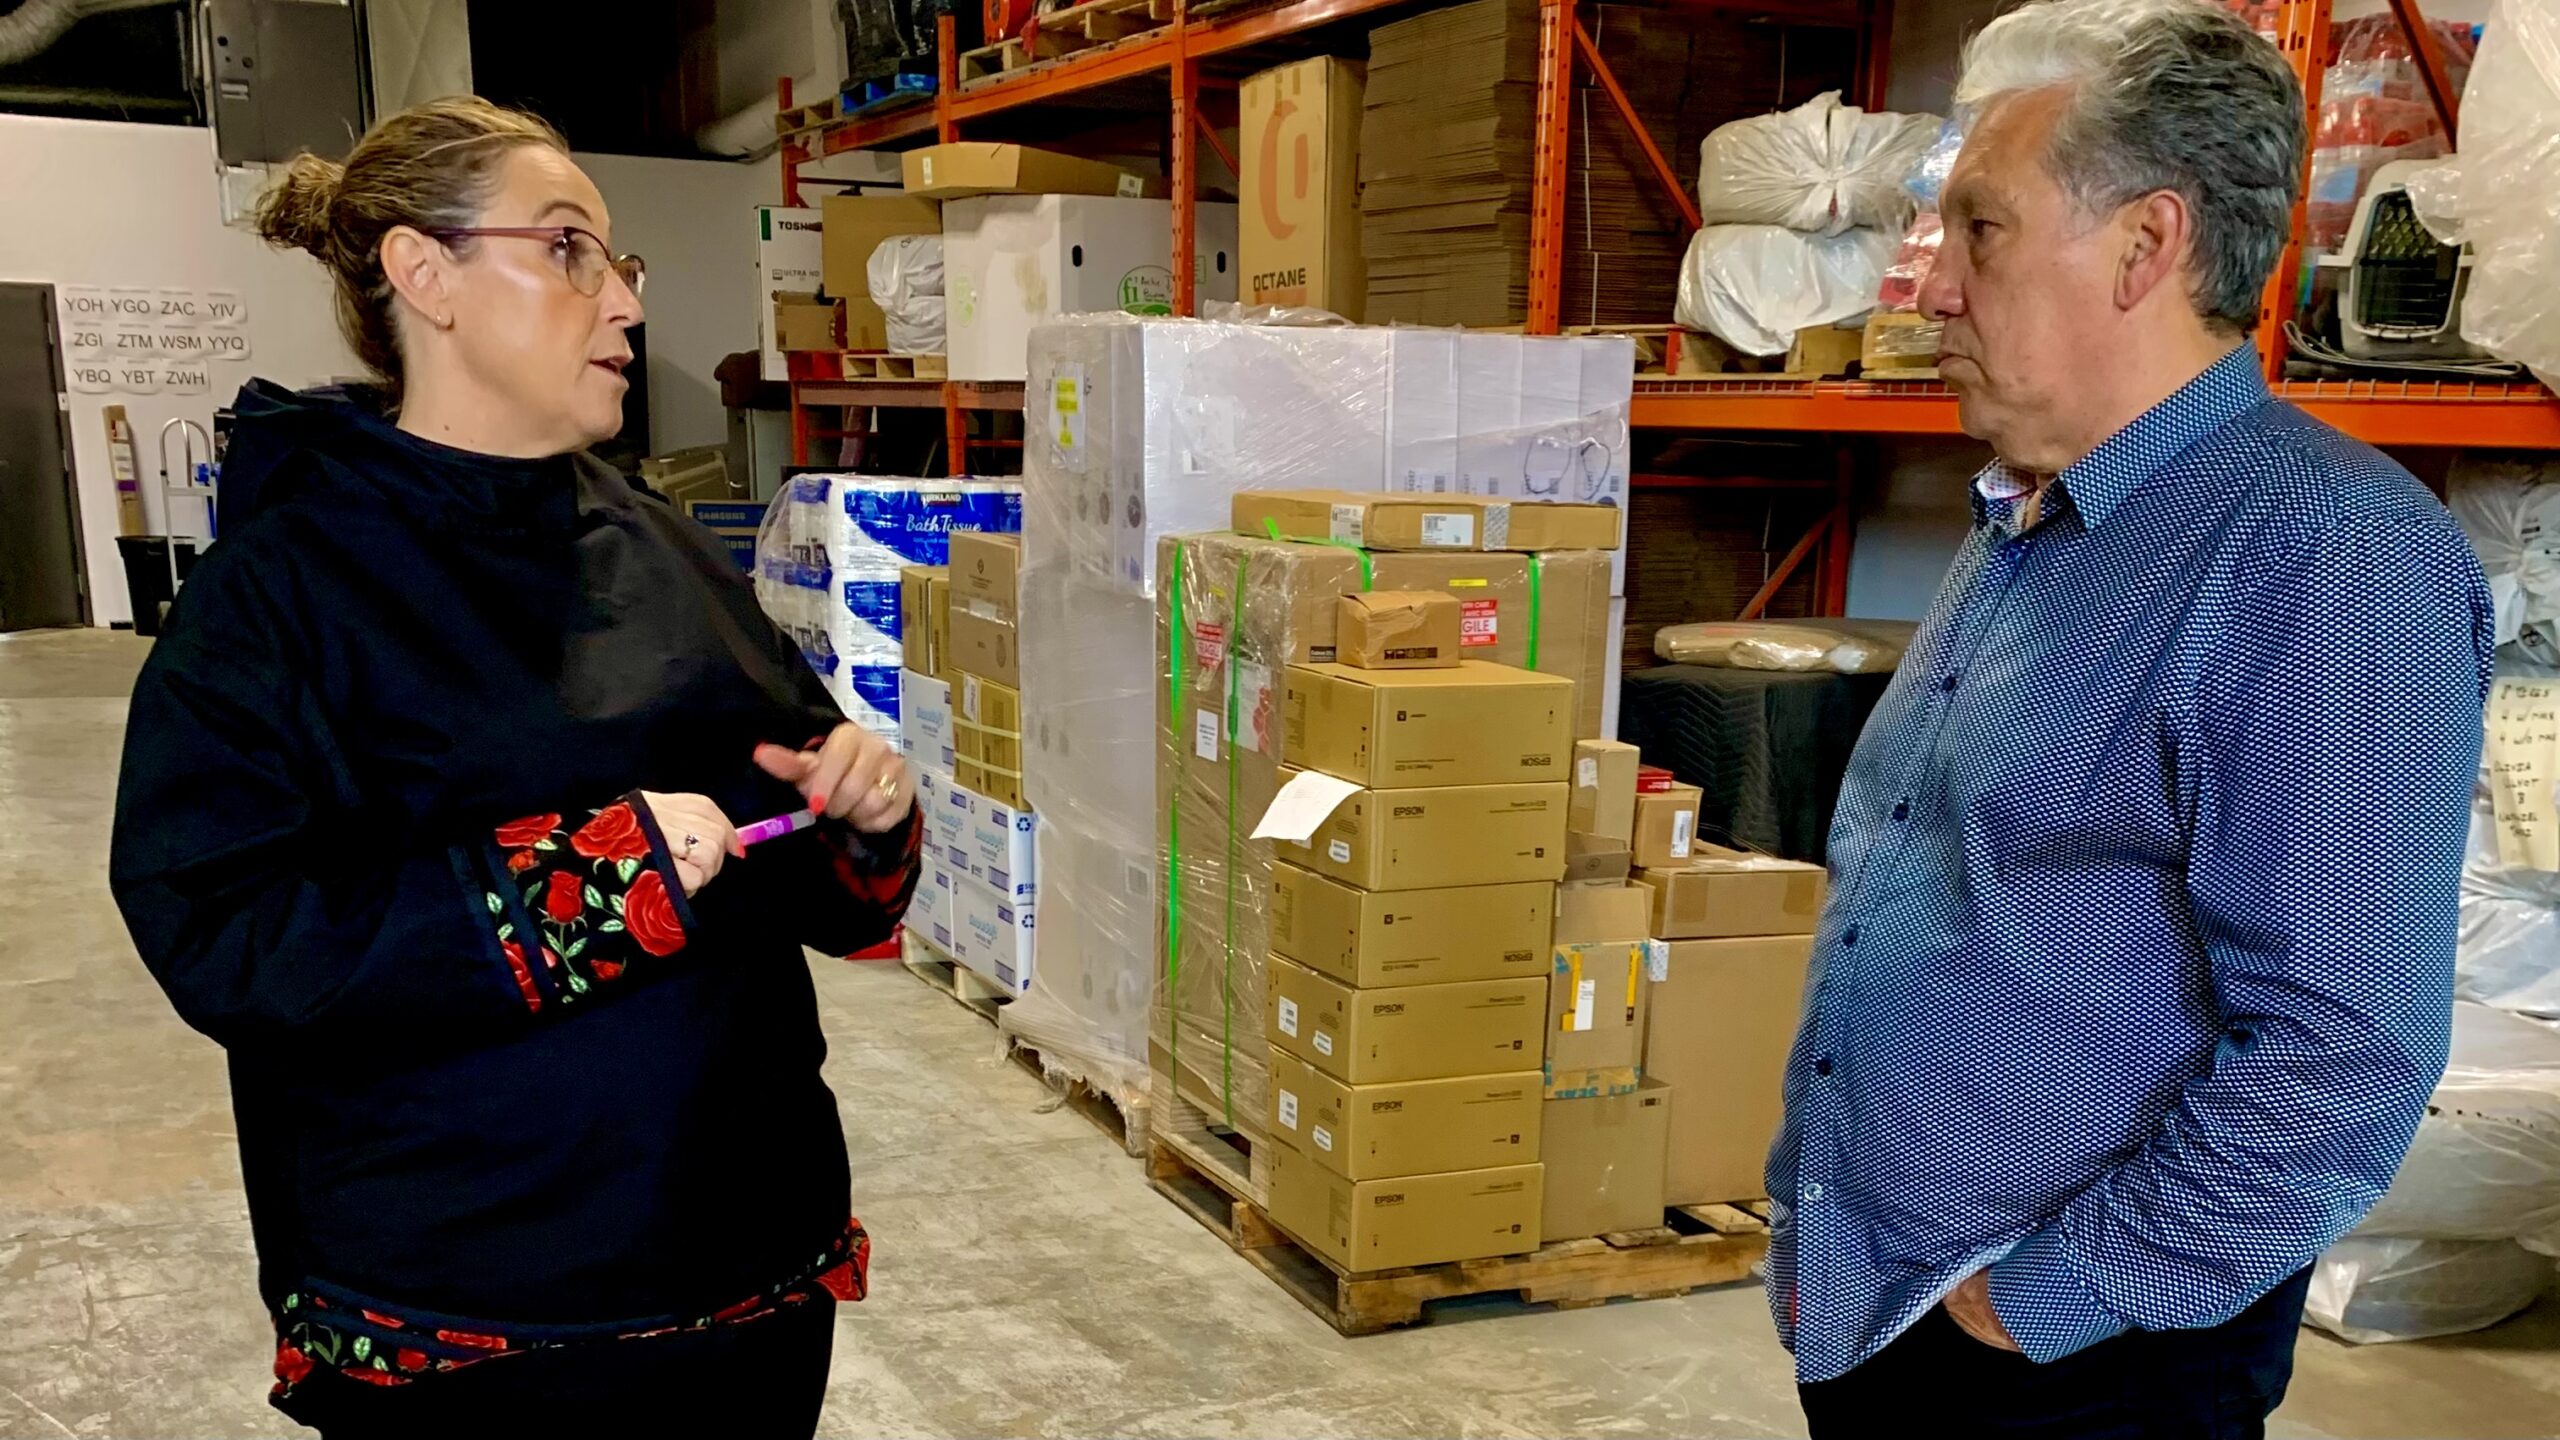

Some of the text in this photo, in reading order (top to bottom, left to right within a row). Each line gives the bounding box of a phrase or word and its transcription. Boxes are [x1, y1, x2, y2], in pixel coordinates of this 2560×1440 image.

[1253, 267, 1306, 292] OCTANE
[65, 298, 236, 317] YOH YGO ZAC YIV
[73, 332, 244, 350] ZGI ZTM WSM YYQ
[73, 368, 205, 385] YBQ YBT ZWH
[920, 494, 962, 503] KIRKLAND
[697, 511, 746, 520] SAMSUNG
[906, 514, 982, 532] Bath Tissue
[1463, 620, 1490, 633] GILE
[1521, 757, 1551, 766] EPSON
[1393, 806, 1425, 816] EPSON
[1504, 953, 1533, 962] EPSON
[1374, 1004, 1405, 1014] EPSON
[1373, 1101, 1403, 1111] EPSON
[1375, 1194, 1404, 1204] EPSON
